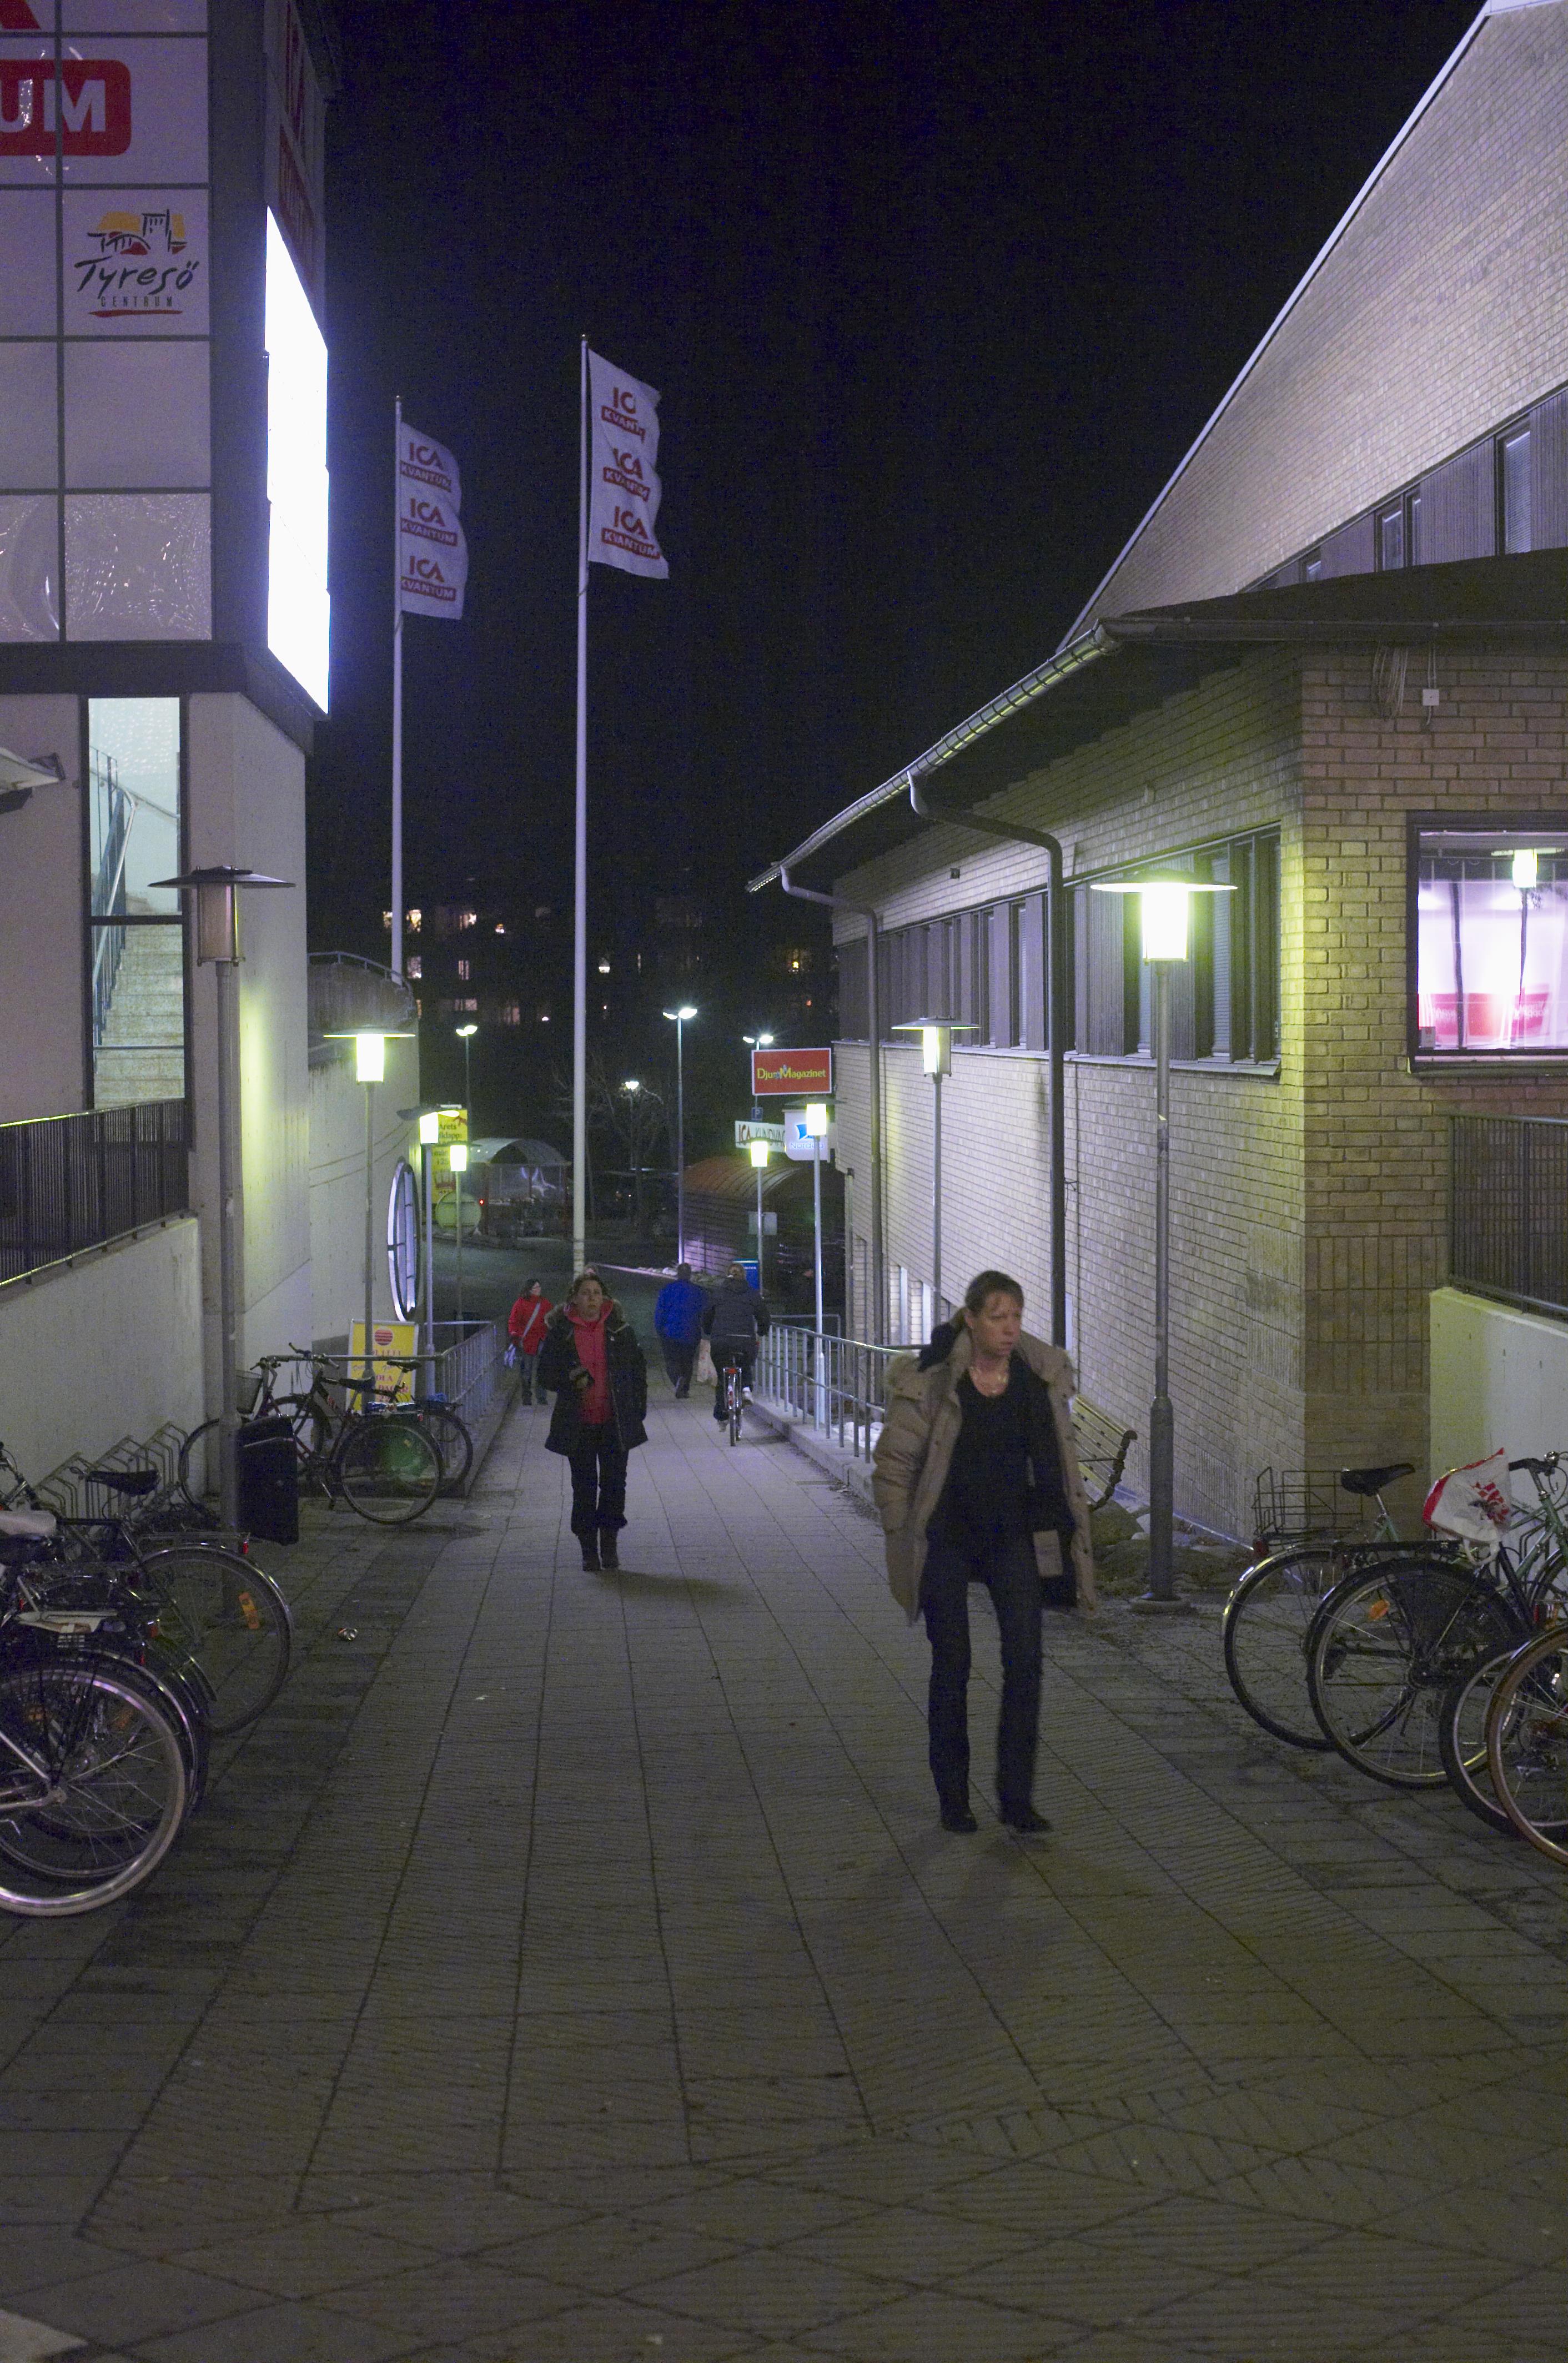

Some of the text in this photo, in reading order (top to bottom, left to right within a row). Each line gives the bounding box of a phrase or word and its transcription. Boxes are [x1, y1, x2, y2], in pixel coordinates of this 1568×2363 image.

[74, 256, 199, 299] Tyresö
[101, 296, 173, 307] CENTRUM
[409, 443, 444, 471] ICA
[613, 448, 643, 480] ICA
[410, 498, 445, 527] ICA
[614, 506, 649, 539] ICA
[401, 520, 455, 544] KVANTUM
[410, 556, 445, 582] ICA
[401, 578, 454, 600] KVANTUM
[738, 1124, 751, 1145] ICA
